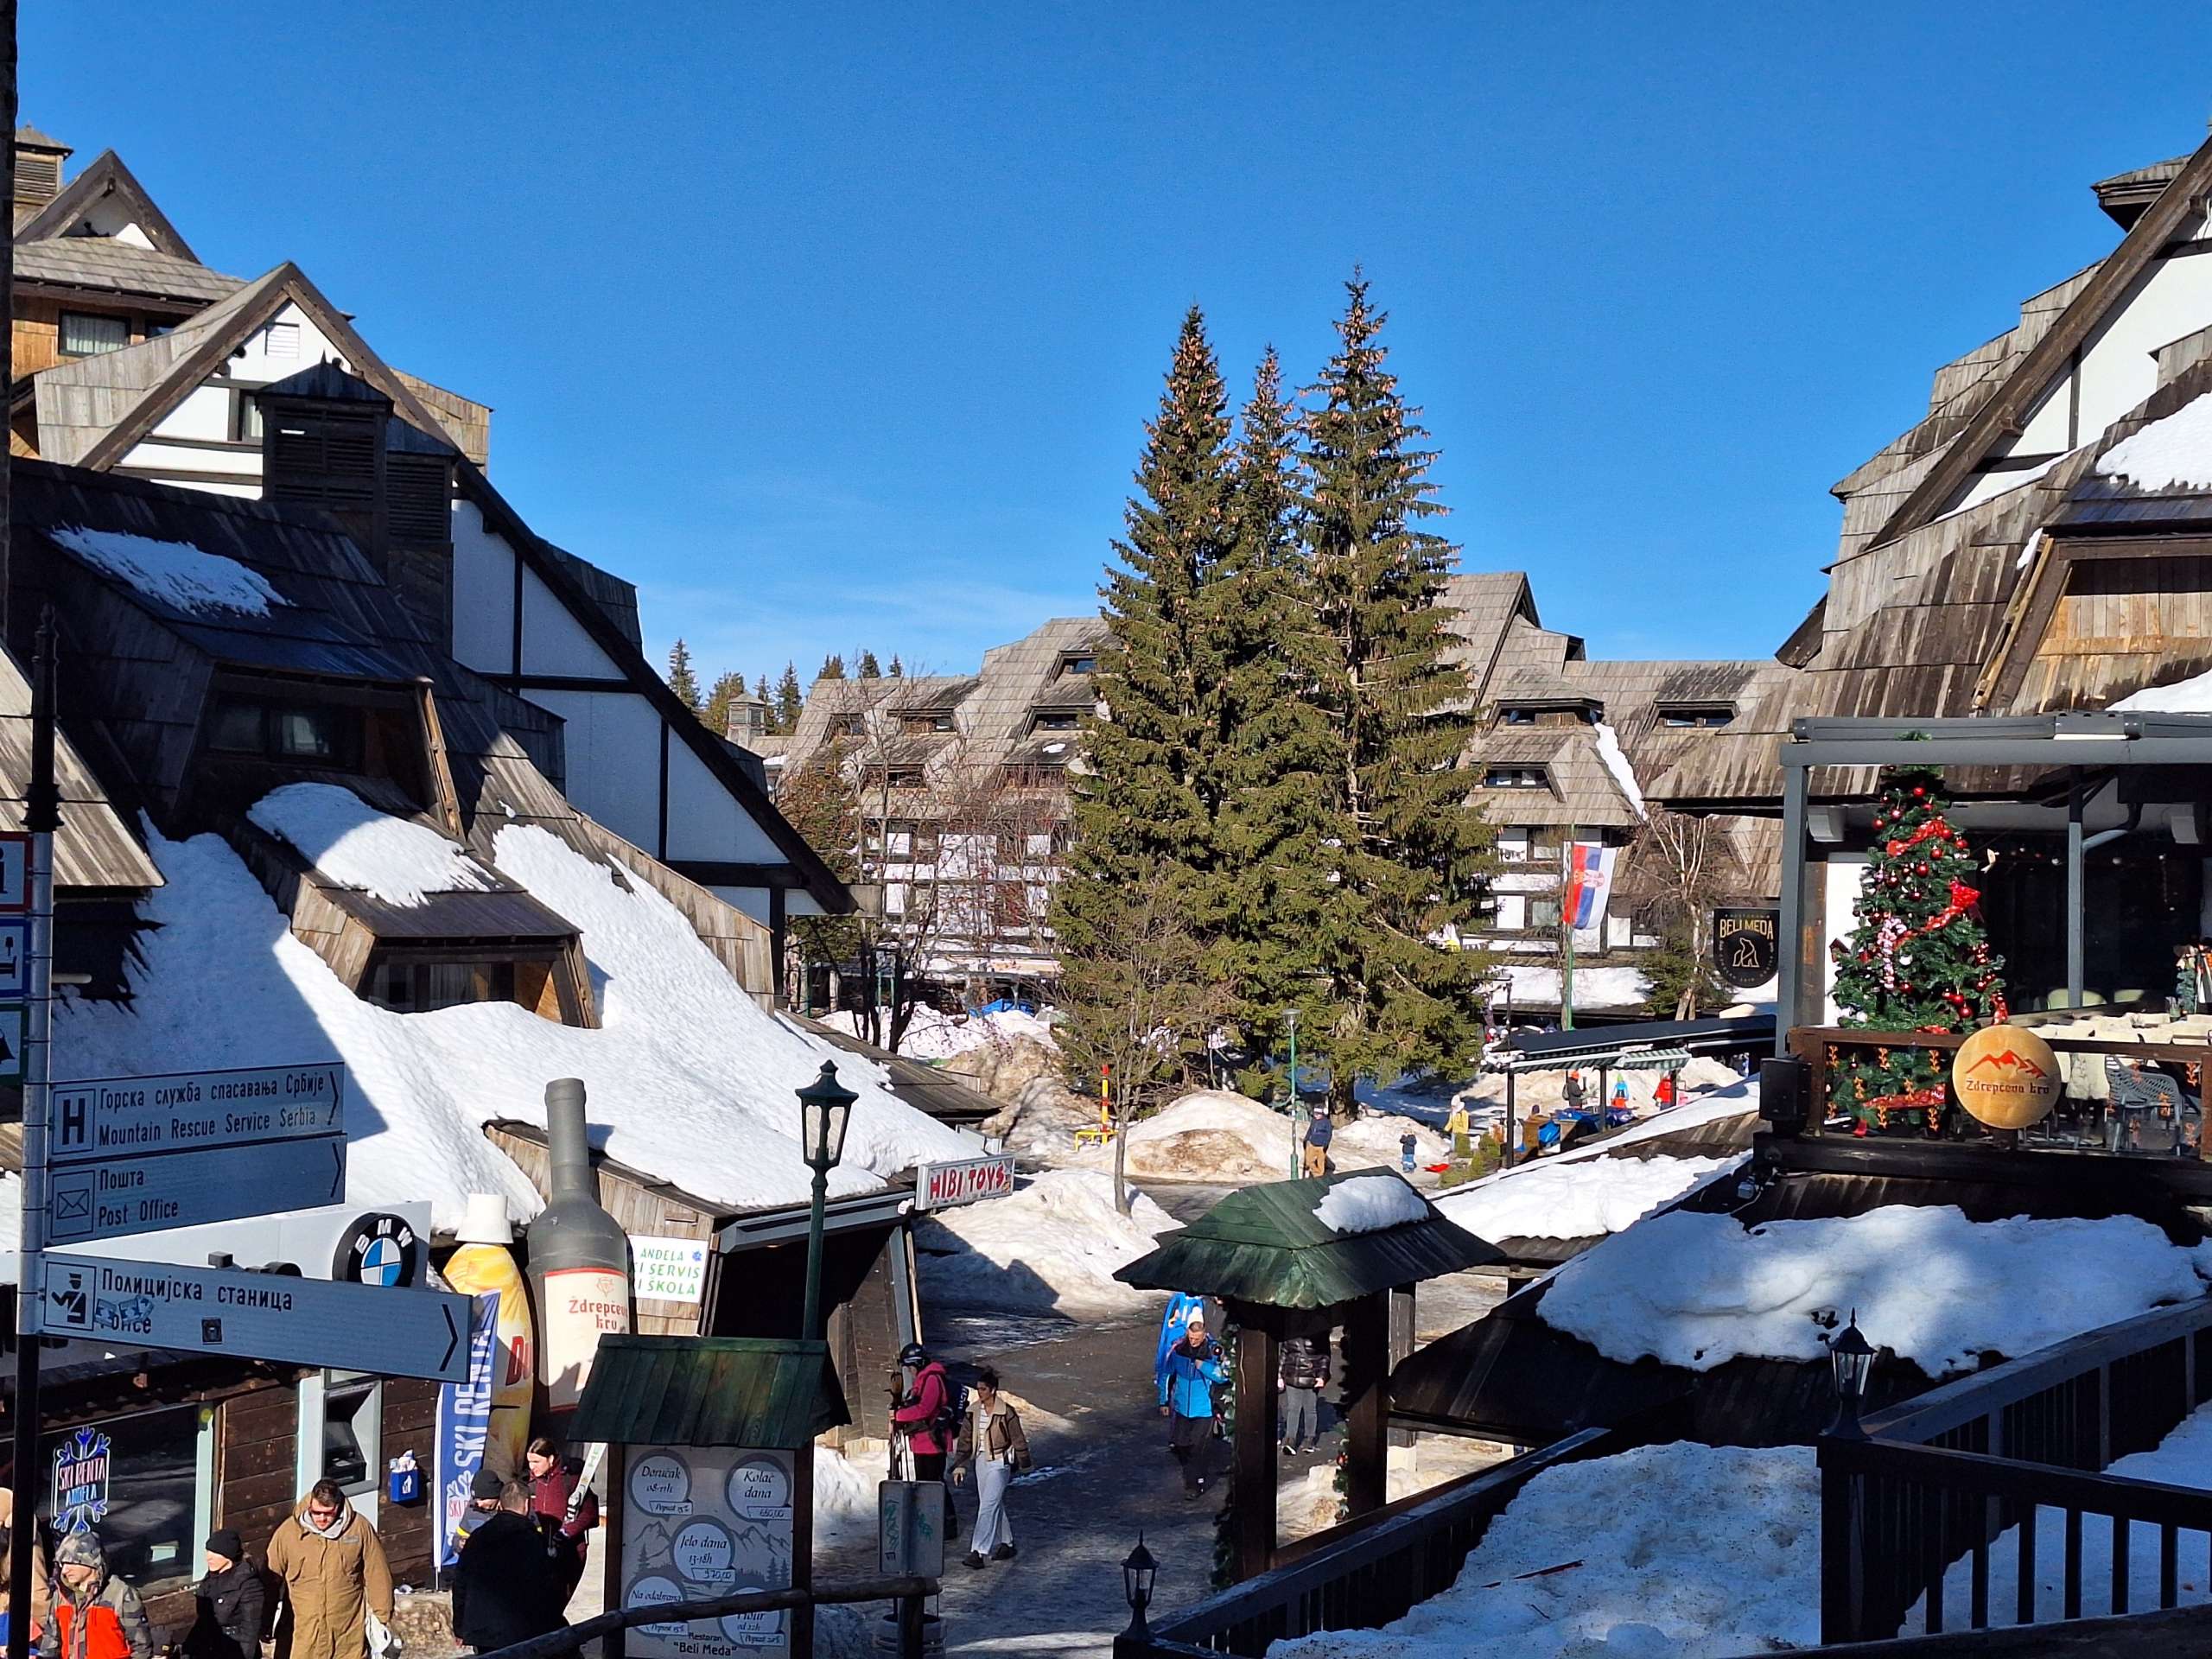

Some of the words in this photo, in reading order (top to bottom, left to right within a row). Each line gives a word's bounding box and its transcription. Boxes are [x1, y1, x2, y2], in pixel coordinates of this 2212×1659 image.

[1719, 918, 1742, 938] BELI
[1745, 919, 1774, 940] MEDA
[100, 1088, 144, 1113] Горска
[156, 1081, 200, 1109] служба
[211, 1080, 277, 1100] спасавања
[286, 1071, 324, 1097] Србије
[99, 1121, 161, 1147] Mountain
[171, 1118, 215, 1139] Rescue
[226, 1112, 270, 1134] Service
[280, 1106, 315, 1128] Serbia
[99, 1169, 144, 1191] Пошта
[930, 1168, 963, 1199] HIBI
[969, 1163, 1005, 1192] TOYS
[99, 1205, 129, 1227] Post
[139, 1198, 179, 1221] Office
[354, 1218, 413, 1255] BMW
[646, 1275, 696, 1295] ŠKOLA
[649, 1263, 701, 1279] SERVIS
[102, 1268, 202, 1302] Полицијска
[218, 1285, 292, 1312] станица
[454, 1426, 487, 1467] SKI
[59, 1465, 74, 1491] SKI
[75, 1457, 105, 1486] RENTA
[745, 1486, 772, 1498] dana
[701, 1535, 728, 1548] dana
